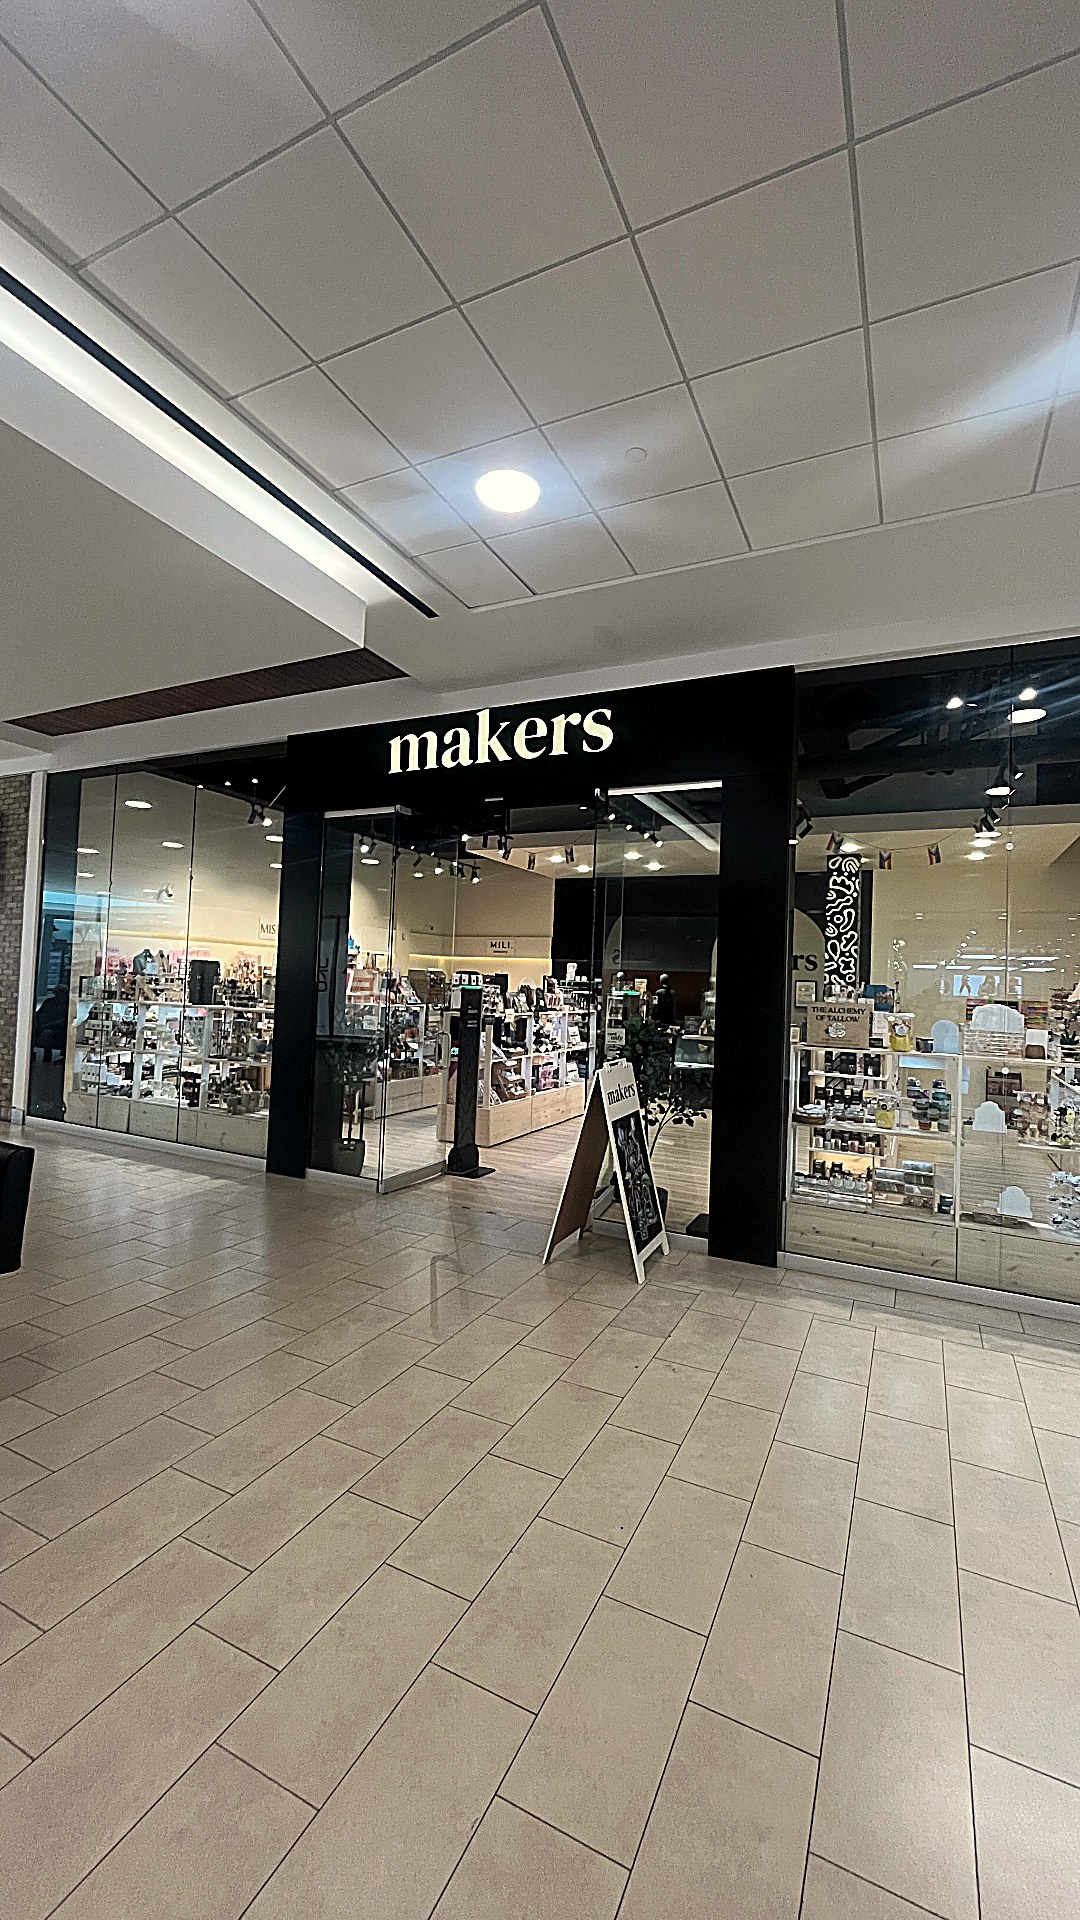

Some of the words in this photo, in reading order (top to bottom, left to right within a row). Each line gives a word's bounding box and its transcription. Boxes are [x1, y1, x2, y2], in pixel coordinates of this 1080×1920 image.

[388, 708, 614, 775] makers
[811, 1006, 827, 1014] THE
[828, 1006, 866, 1015] ALCHEMY
[826, 1015, 860, 1023] TALLOW
[607, 1083, 636, 1106] makers
